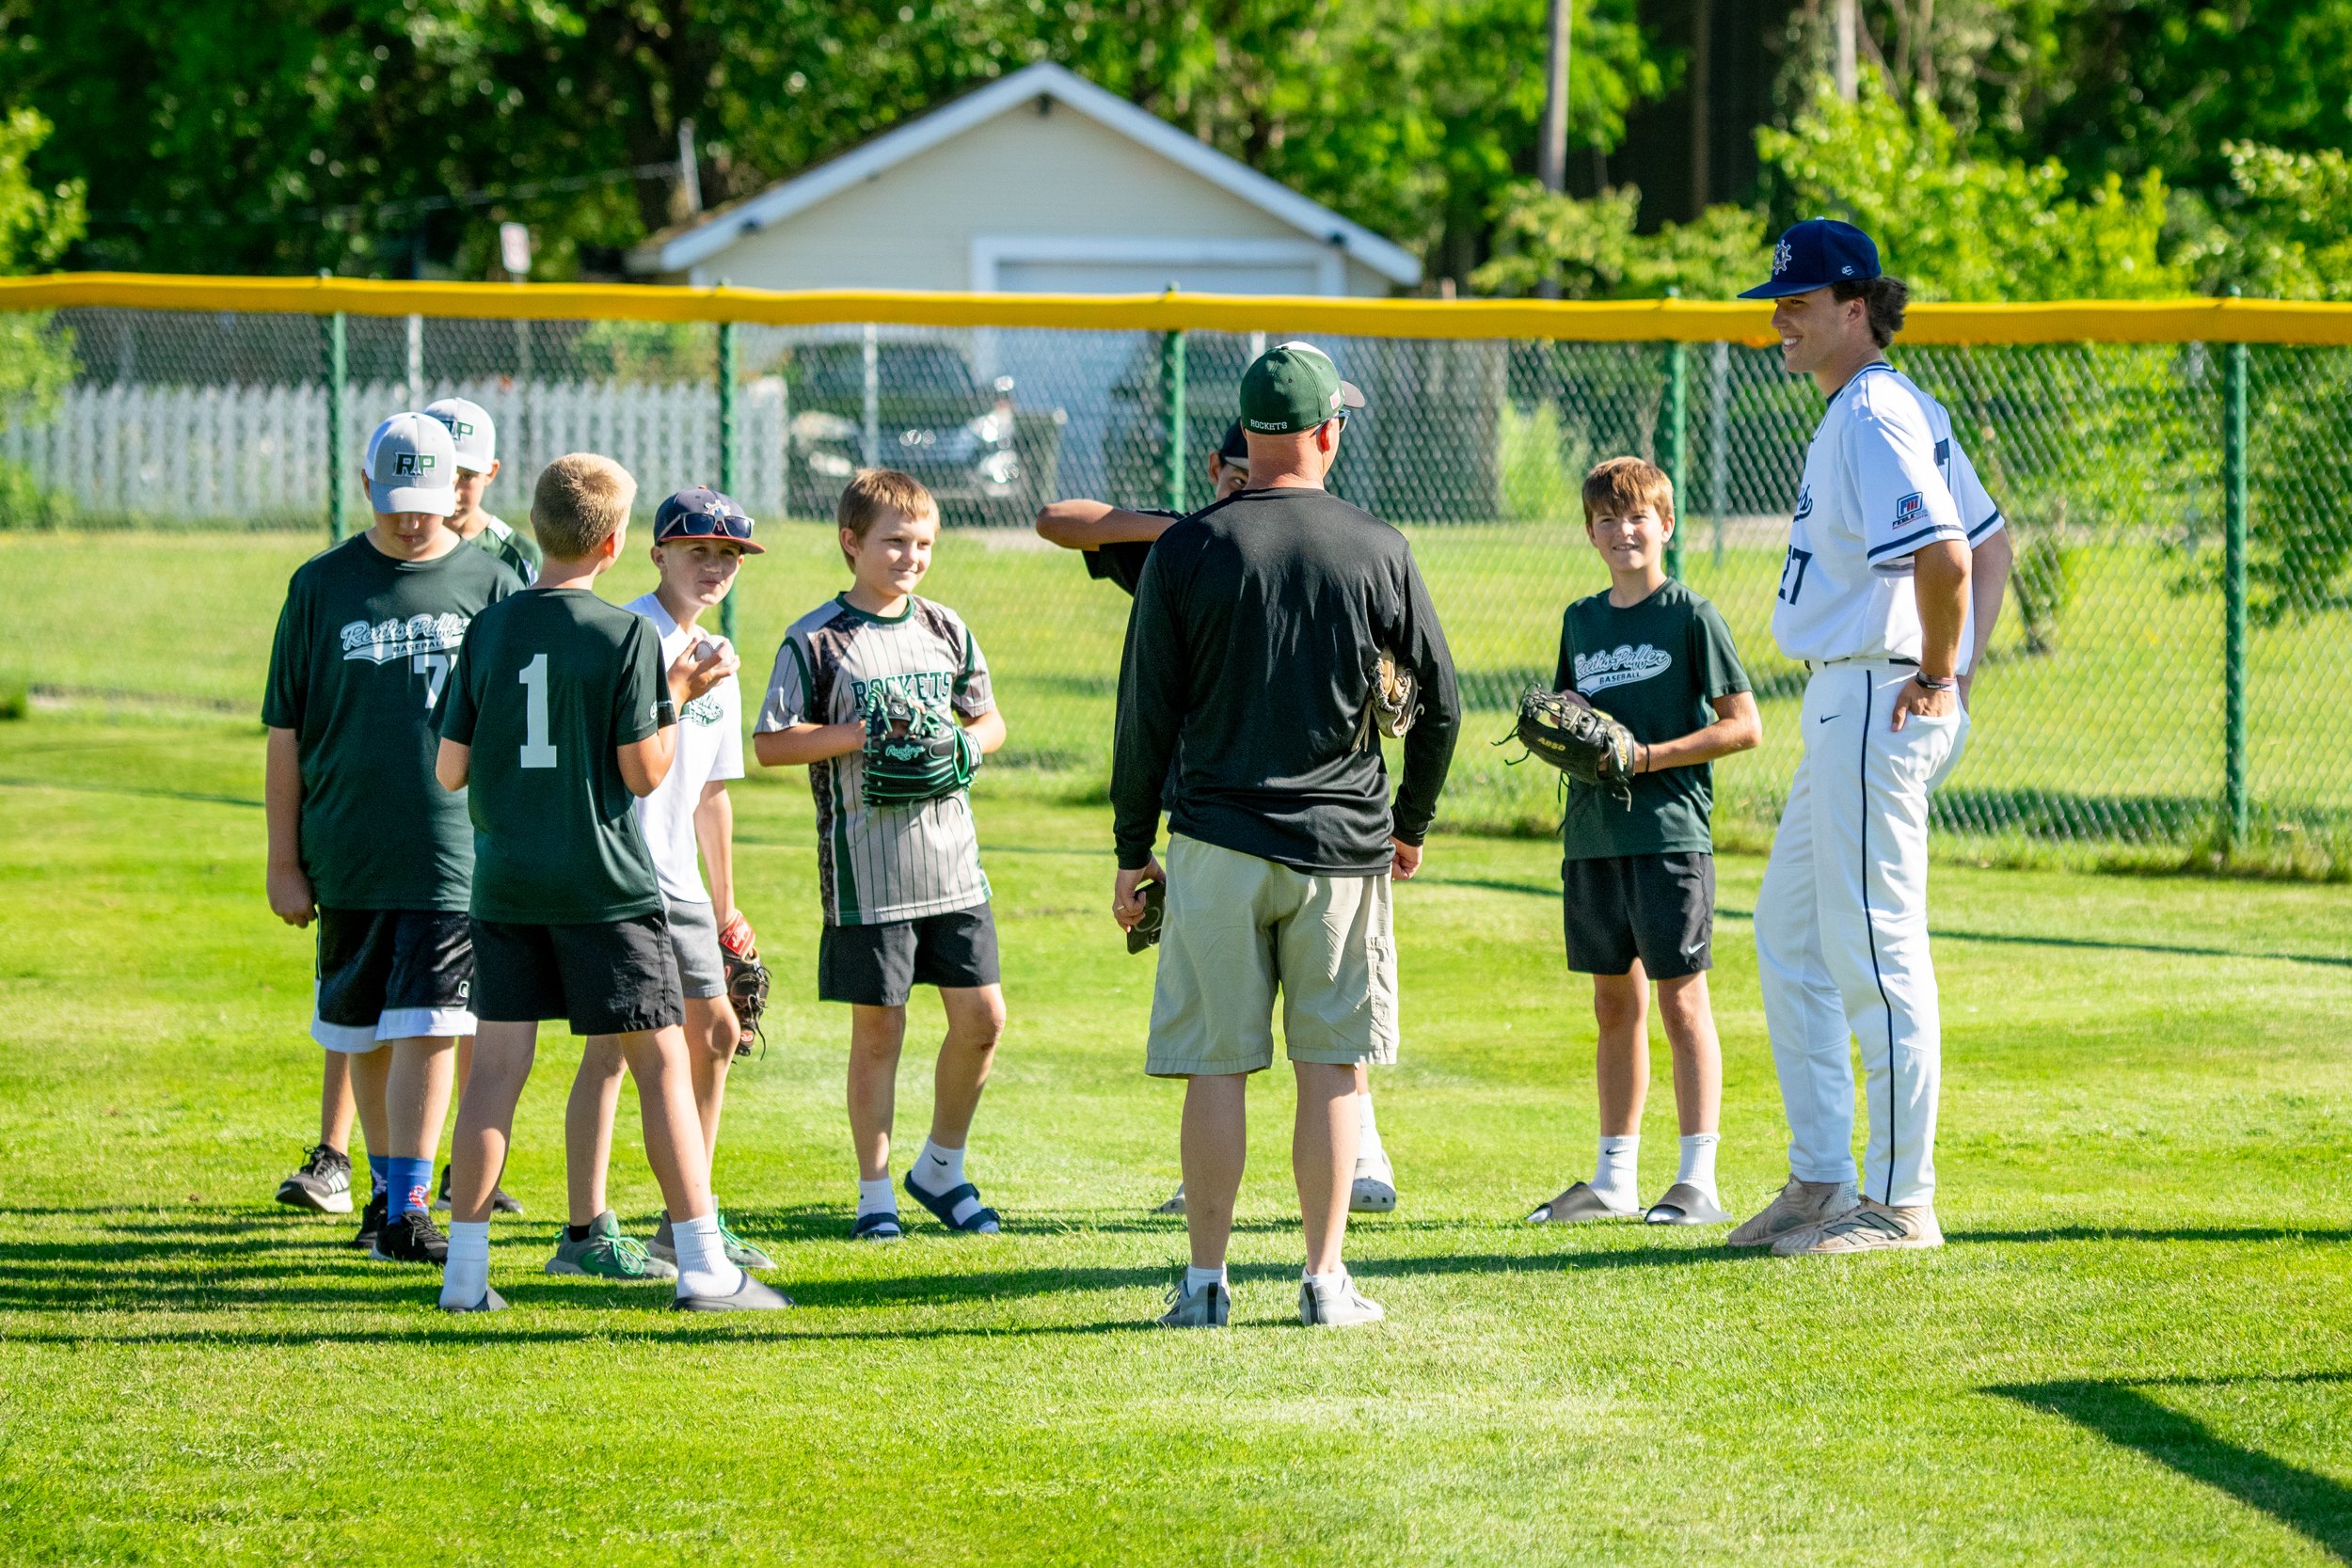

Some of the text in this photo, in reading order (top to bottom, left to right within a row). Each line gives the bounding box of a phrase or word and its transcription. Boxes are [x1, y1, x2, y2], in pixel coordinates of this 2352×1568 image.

[1249, 418, 1288, 431] ROCKETS
[392, 452, 436, 477] RP
[1599, 672, 1641, 685] BASEBALL
[850, 671, 952, 711] ROCKETS
[518, 653, 557, 768] 1
[885, 743, 926, 762] Rawlings
